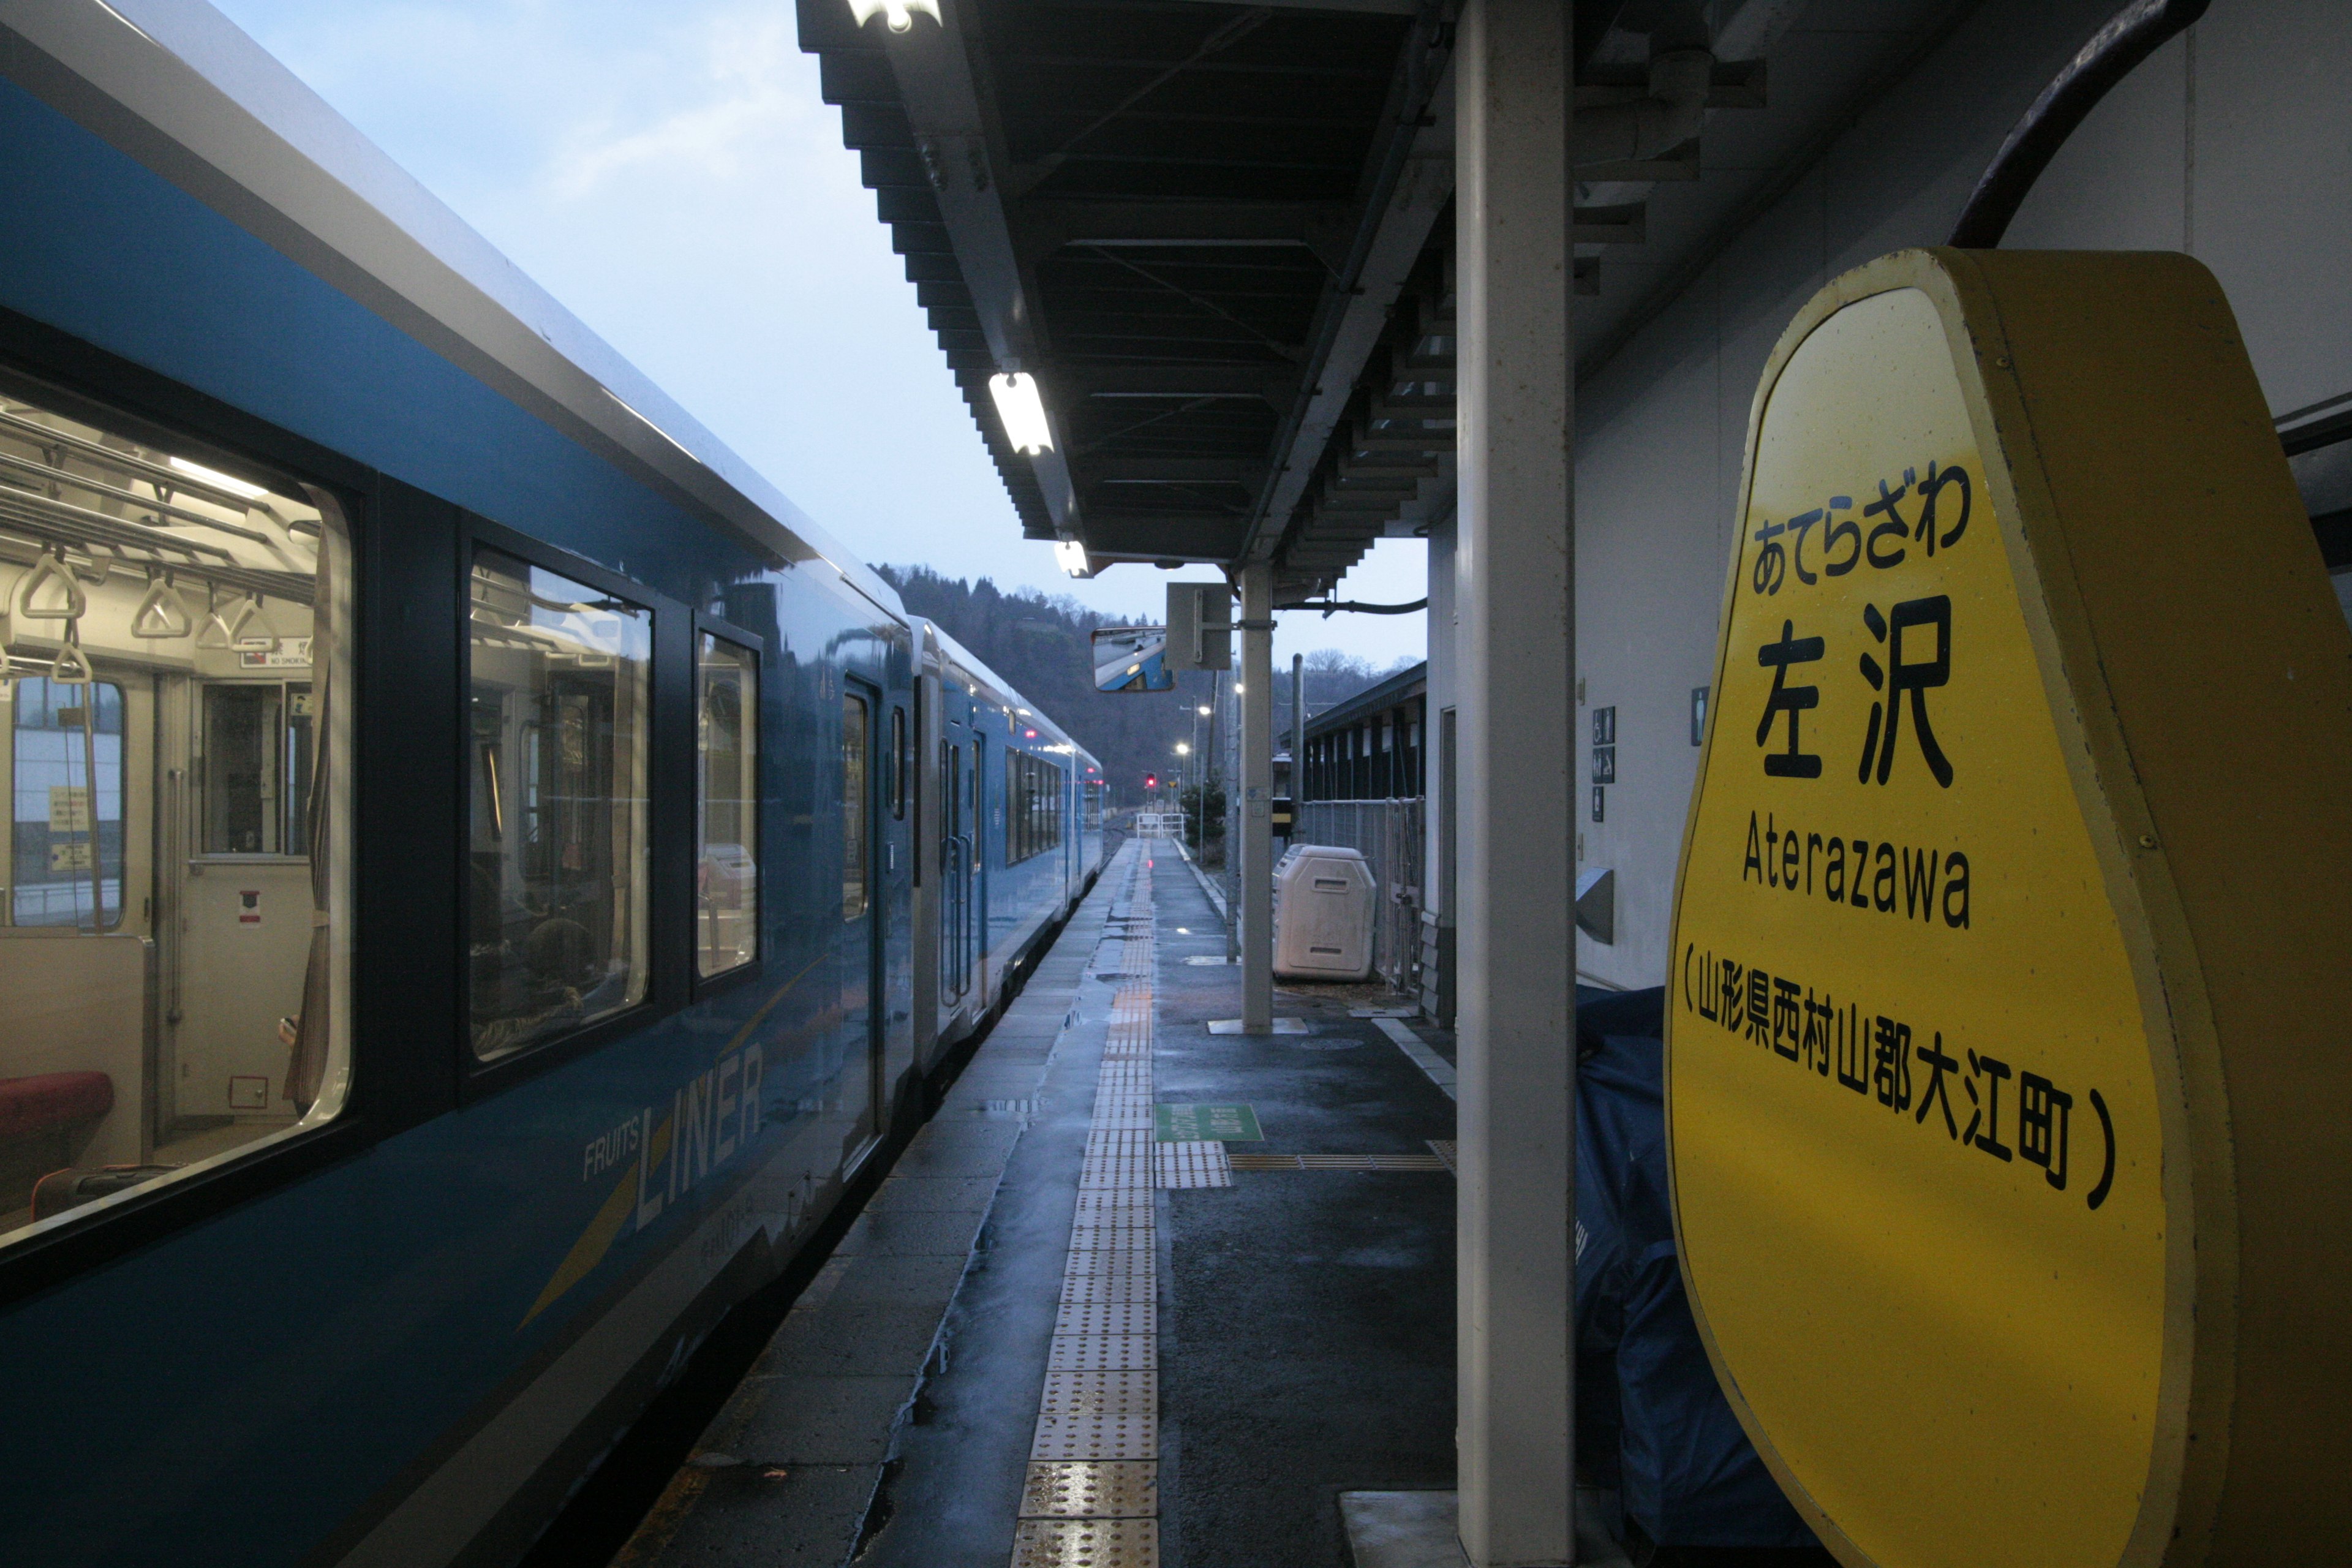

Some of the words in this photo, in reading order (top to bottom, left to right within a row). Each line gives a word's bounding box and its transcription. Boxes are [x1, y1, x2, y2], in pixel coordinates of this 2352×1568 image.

[1753, 459, 1971, 596] あてらざわ
[1756, 594, 1953, 788] 左沢
[1743, 810, 1971, 930] Aterazawa
[583, 1115, 639, 1182] FRUITS
[636, 1042, 763, 1232] LINER
